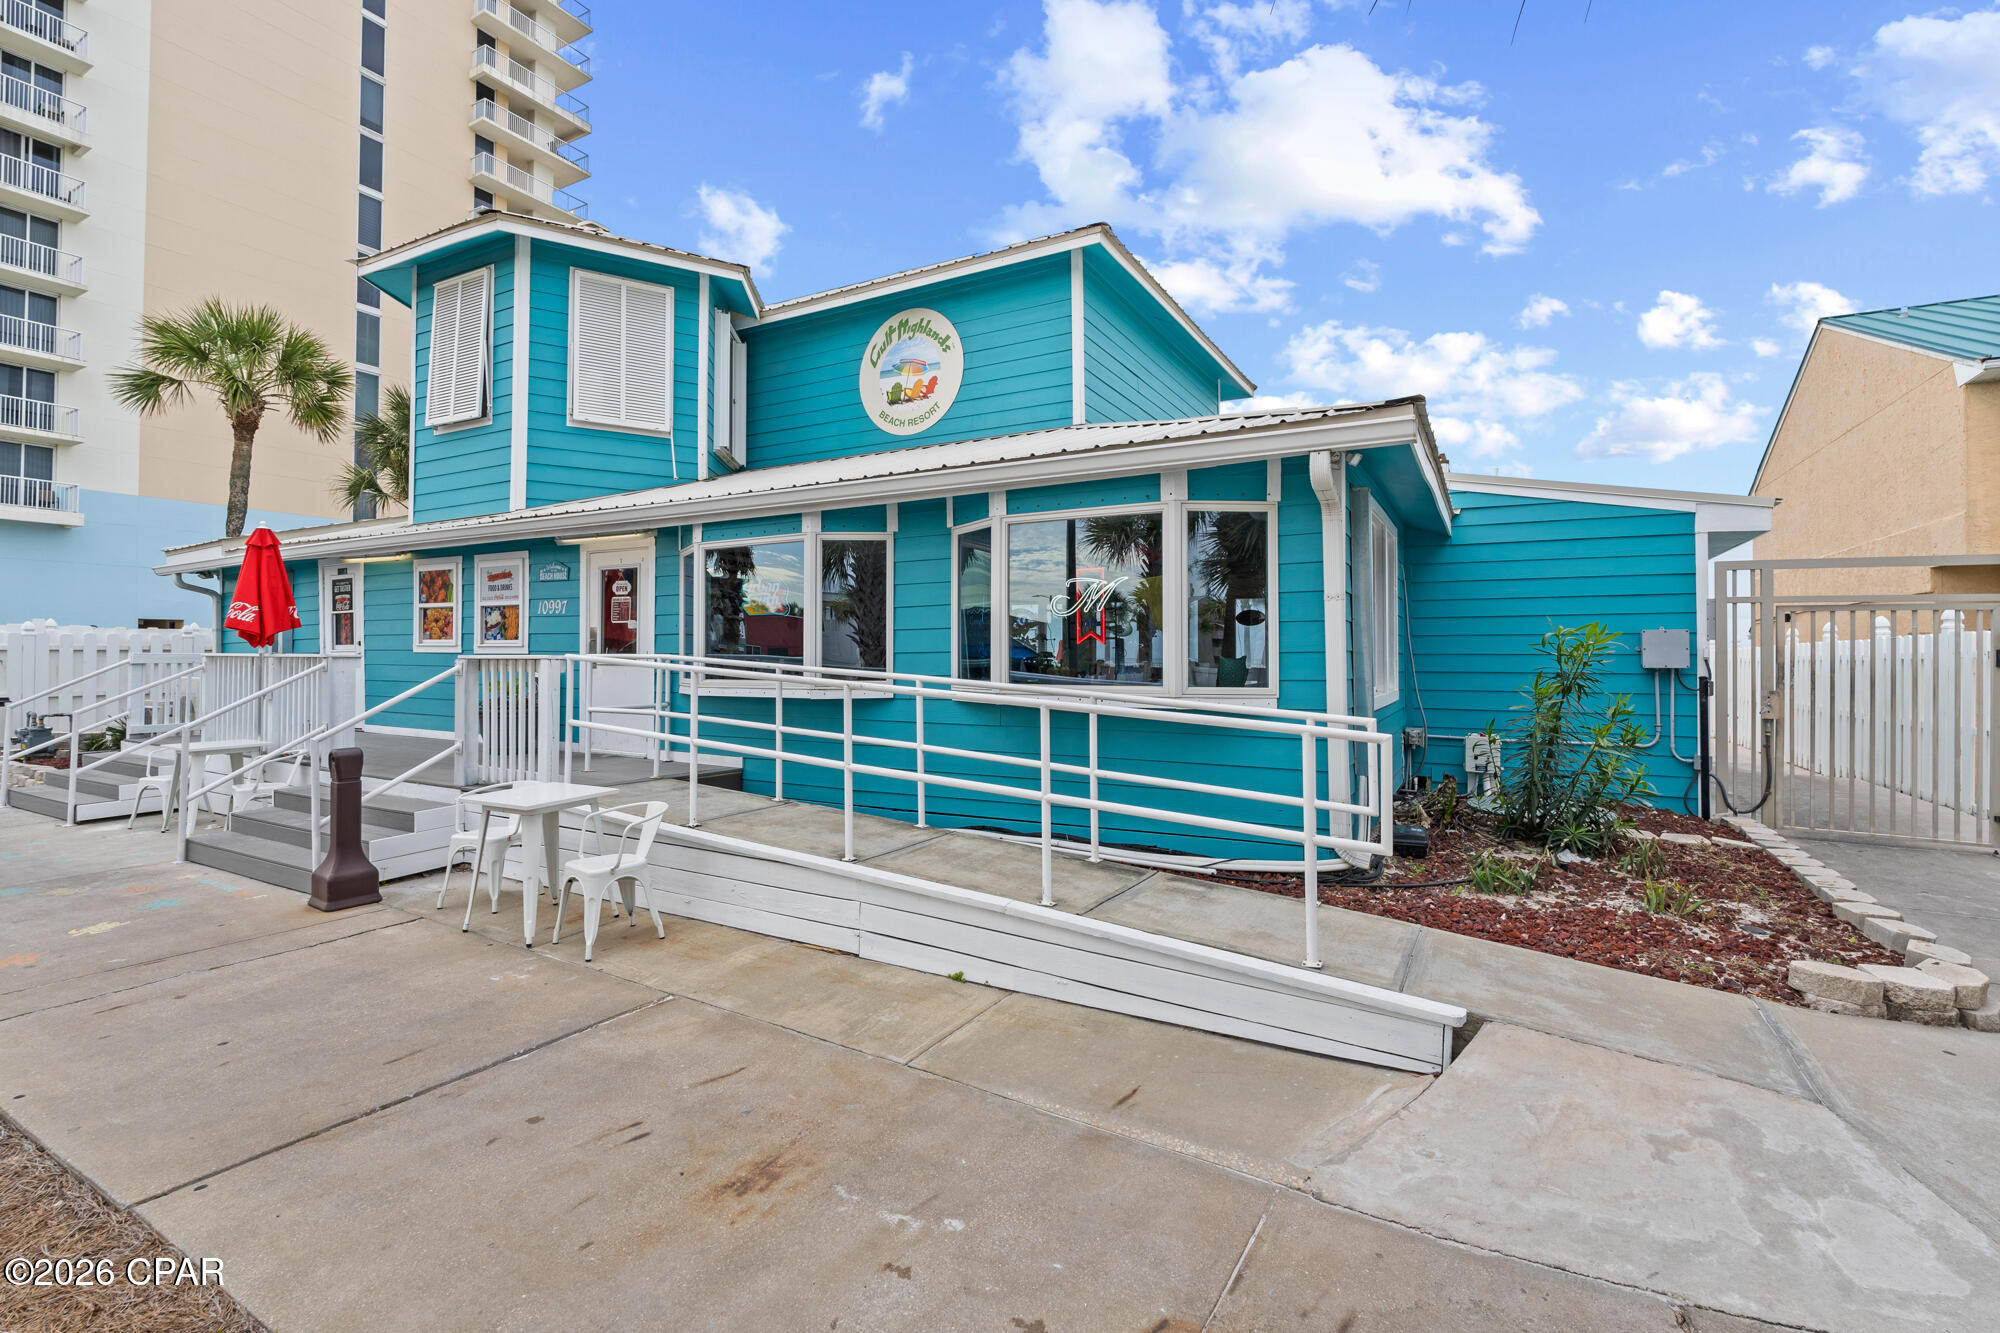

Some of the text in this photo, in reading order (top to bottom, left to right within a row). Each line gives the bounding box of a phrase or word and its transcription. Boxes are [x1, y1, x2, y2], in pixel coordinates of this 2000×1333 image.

[869, 317, 951, 368] Gulf Highlands
[879, 401, 941, 428] BEACH RESORT
[537, 599, 569, 615] 10997
